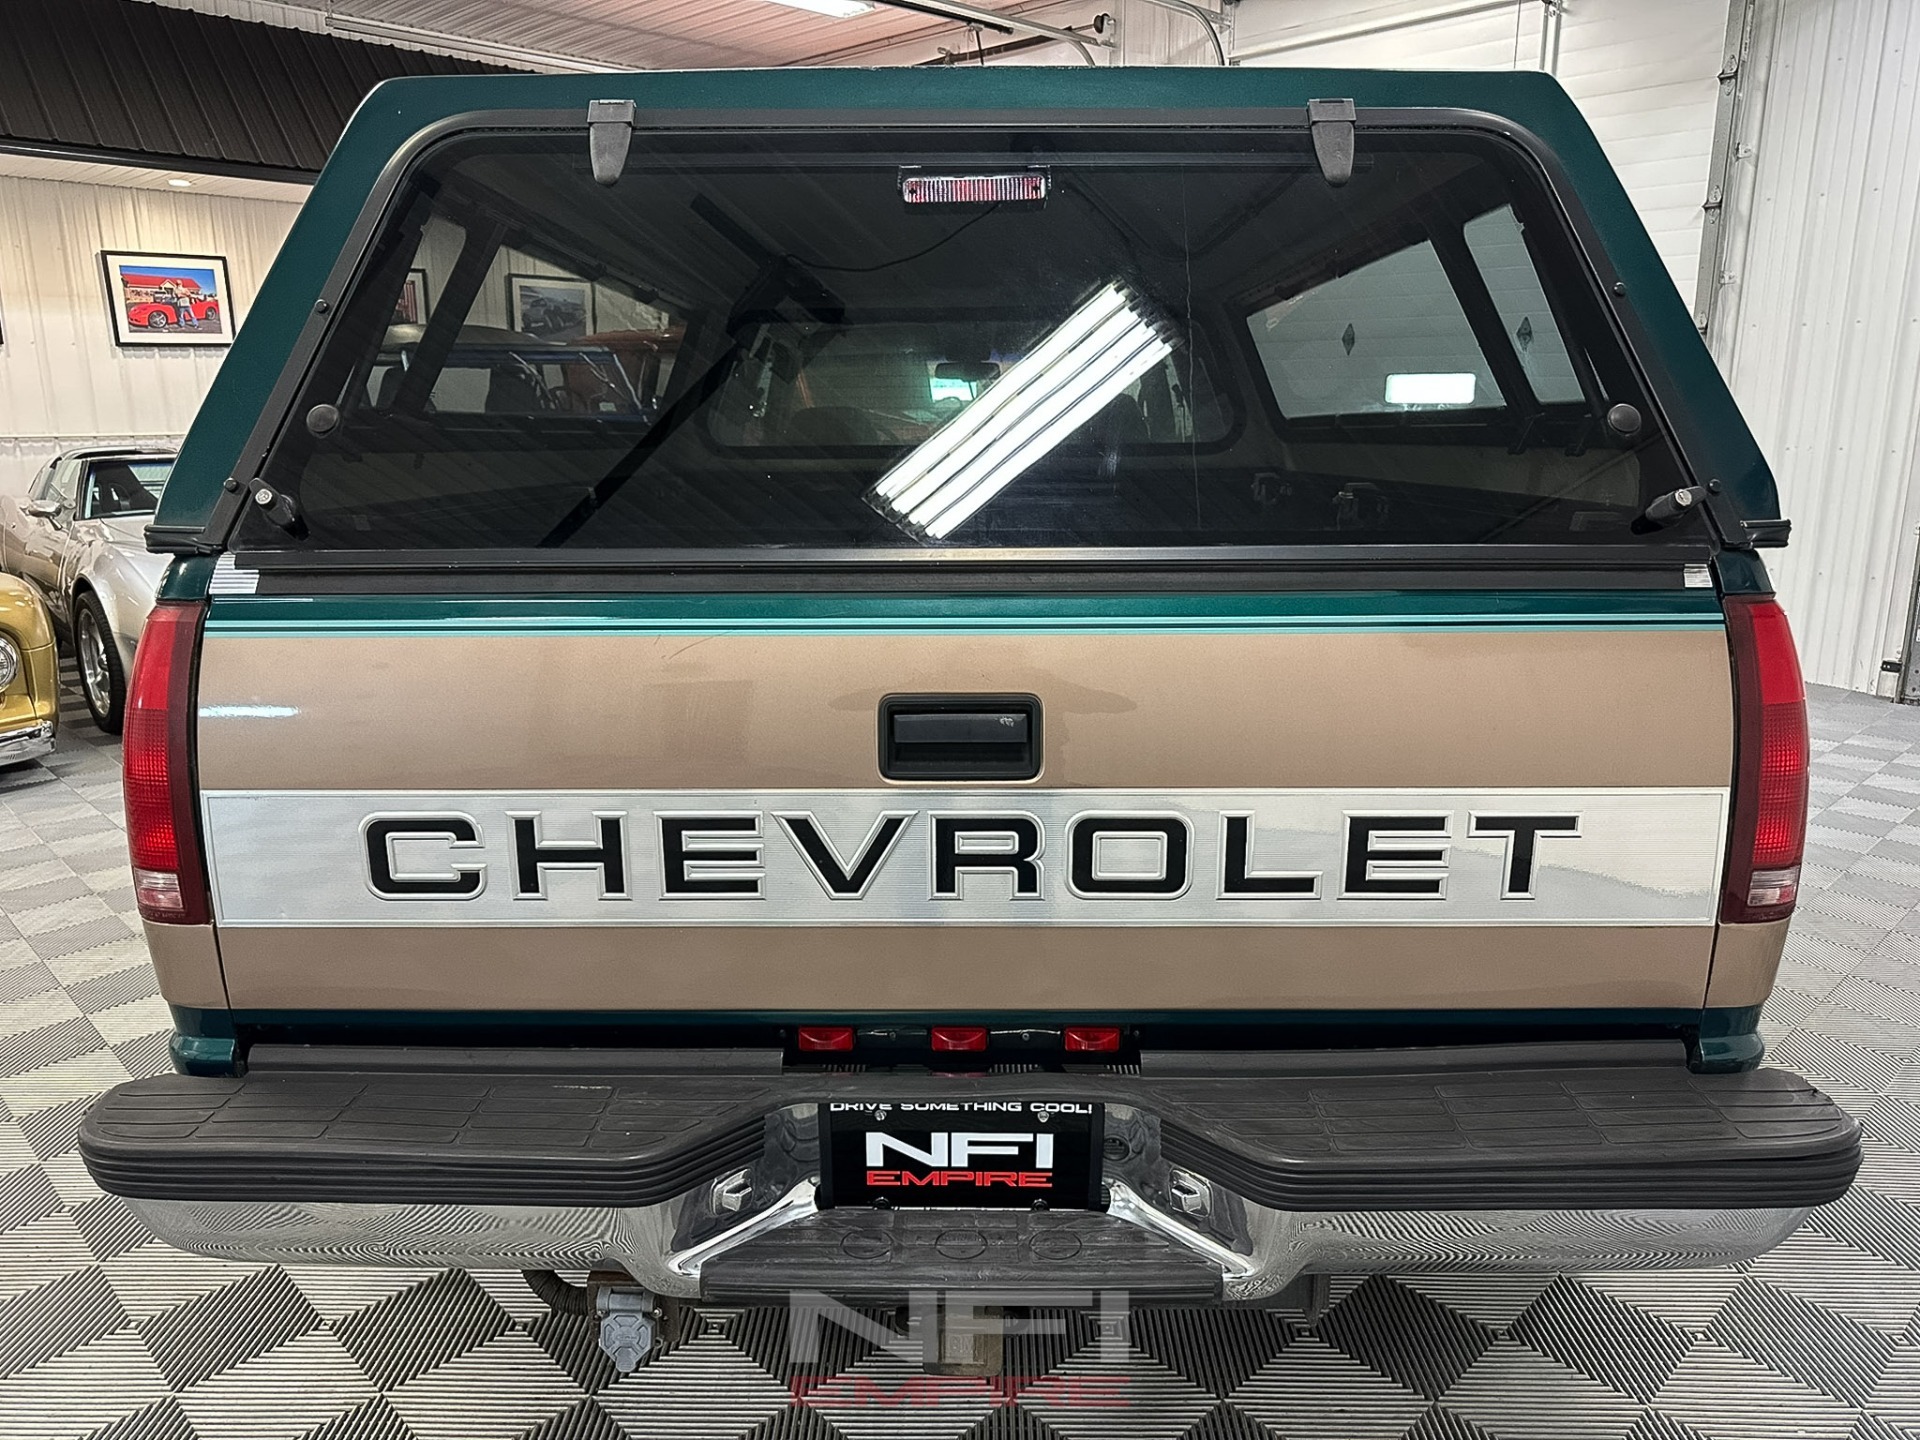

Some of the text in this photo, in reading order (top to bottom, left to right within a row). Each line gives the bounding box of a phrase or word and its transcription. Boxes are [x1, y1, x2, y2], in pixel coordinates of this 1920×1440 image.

[358, 810, 1585, 900] CHEVROLET
[830, 1102, 1092, 1114] DRIVE SOMETHING COOL!
[866, 1132, 1054, 1168] NFI
[866, 1170, 1053, 1187] EMPIRE
